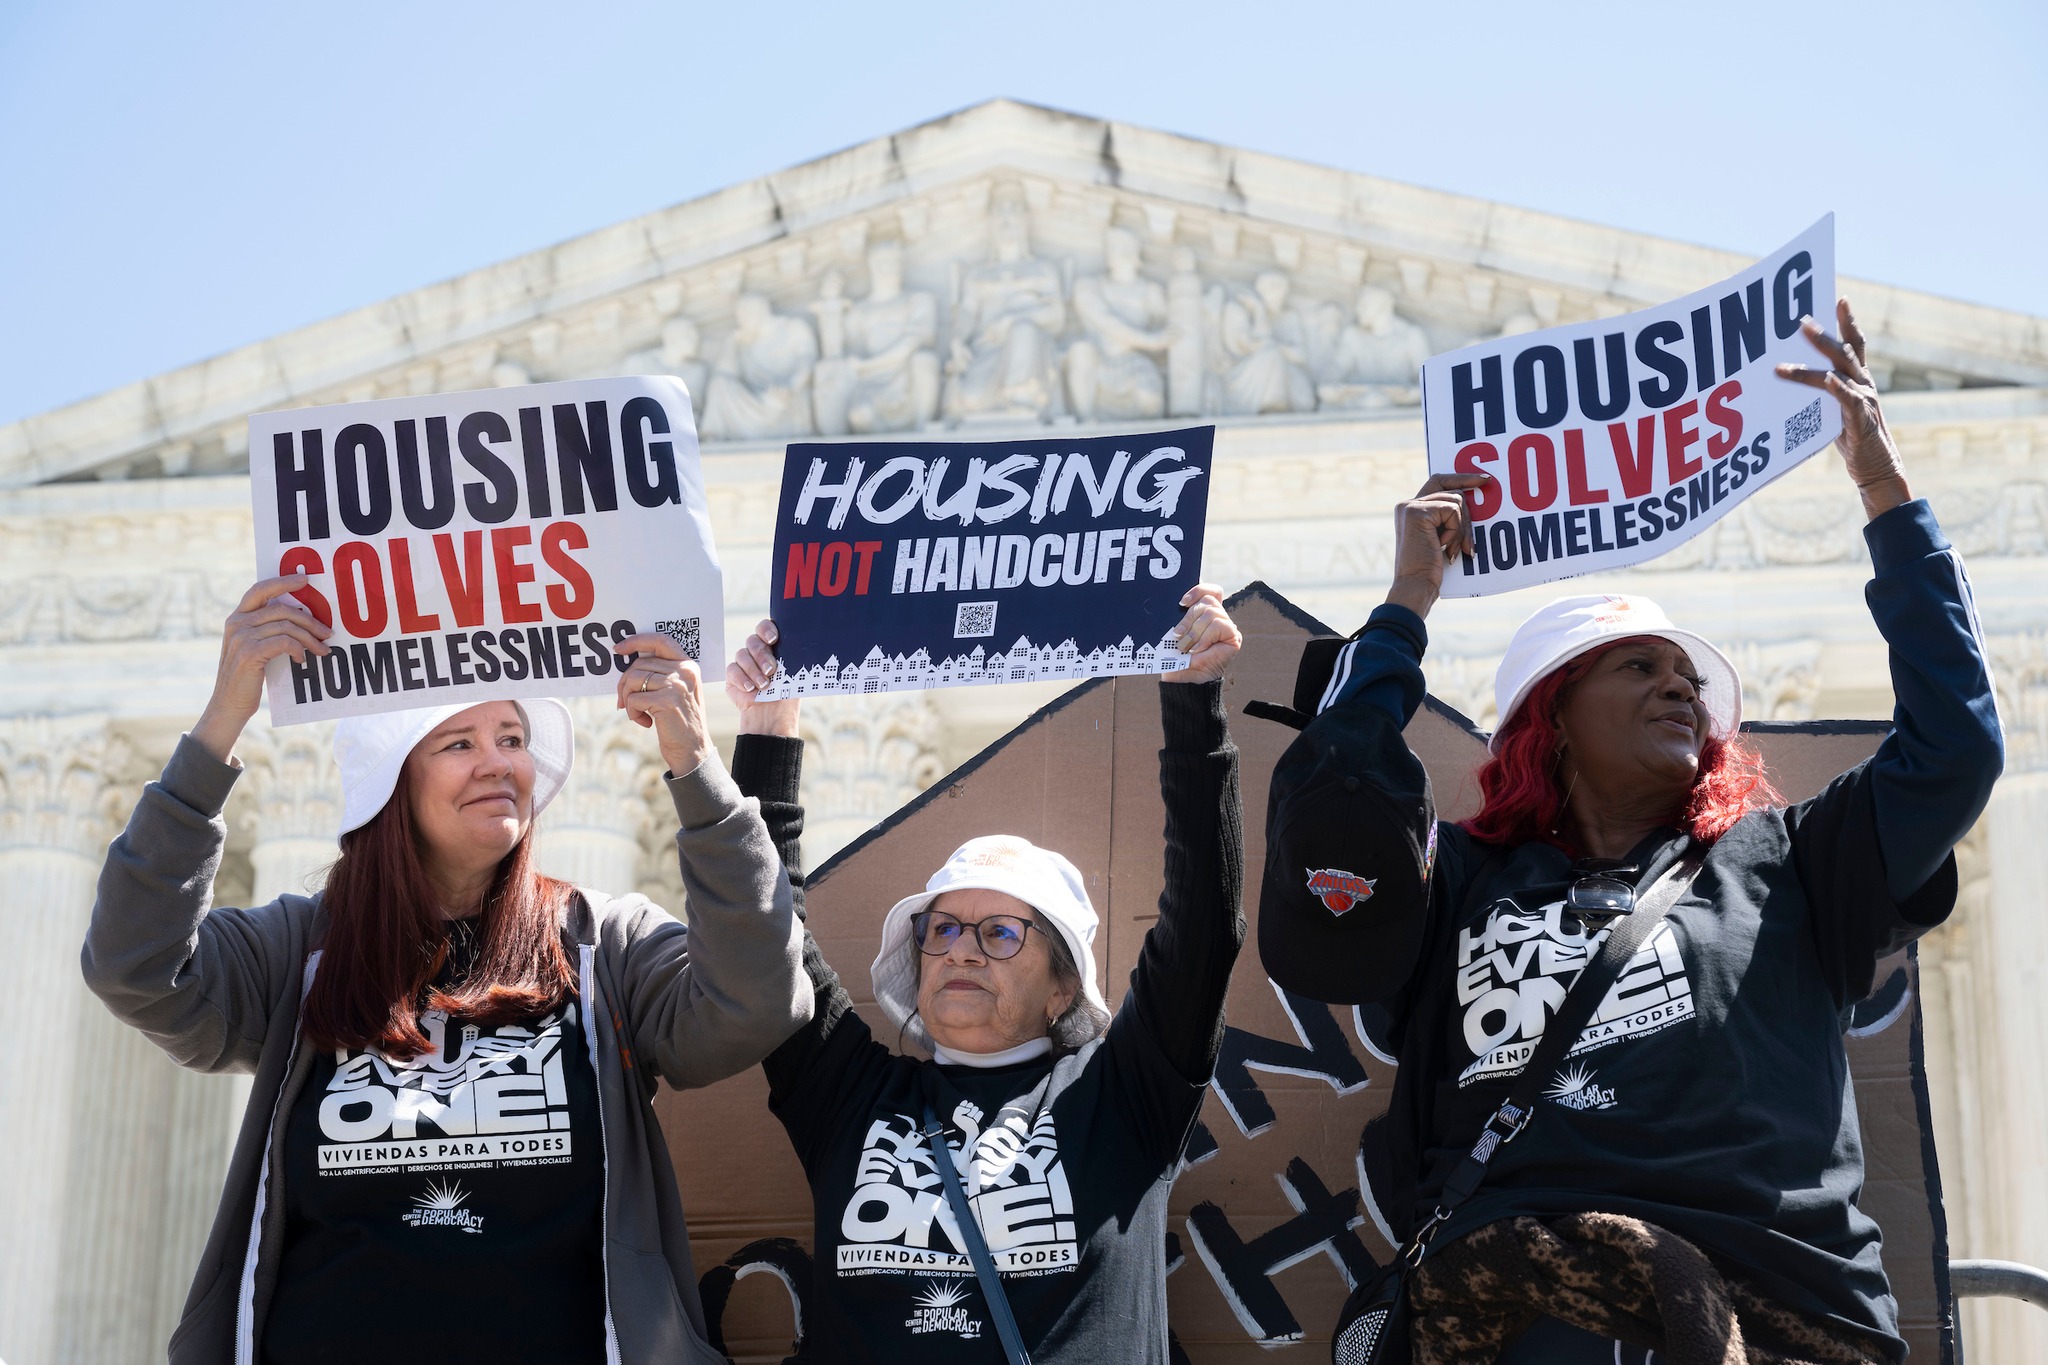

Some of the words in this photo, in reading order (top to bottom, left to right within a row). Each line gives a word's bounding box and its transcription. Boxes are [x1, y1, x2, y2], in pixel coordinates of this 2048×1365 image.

[1452, 250, 1813, 443] HOUSING
[1453, 380, 1743, 522] SOLVES
[273, 396, 682, 543] HOUSING
[794, 446, 1204, 530] HOUSING
[1461, 431, 1771, 576] HOMELESSNESS
[783, 541, 882, 600] NOT
[891, 525, 1184, 594] HANDCUFFS
[279, 521, 595, 639] SOLVES
[290, 620, 639, 704] HOMELESSNESS
[1309, 872, 1372, 895] KNICKS
[1575, 1026, 1614, 1045] ARA
[1624, 1002, 1686, 1028] TODES
[1627, 1026, 1662, 1041] VIVIENDAS
[1663, 1011, 1697, 1029] SOCIALES!
[326, 1036, 562, 1096] EVERY
[318, 1048, 571, 1142] ONE!
[323, 1146, 428, 1163] VIVIENDAS
[438, 1142, 490, 1157] PARA
[501, 1138, 564, 1153] TODES
[408, 1164, 443, 1172] DERECHOS
[454, 1161, 493, 1170] INQUILINES!
[502, 1158, 537, 1167] VIVIENDAS
[538, 1156, 572, 1165] SOCIALES!
[402, 1213, 422, 1221] CENTER
[410, 1219, 421, 1227] FOR
[421, 1215, 484, 1228] DEMOCRACY
[423, 1208, 470, 1218] POPULAR
[841, 1249, 937, 1264] VIVIENDAS
[947, 1254, 998, 1266] PAA
[1008, 1249, 1070, 1265] TODES
[914, 1269, 950, 1277] DERECHOS
[1009, 1270, 1043, 1279] VIVIENDAS
[905, 1318, 922, 1327] CENTER
[914, 1310, 923, 1318] THE
[922, 1318, 982, 1333] DEMOCRACY
[923, 1307, 968, 1322] POPULAR
